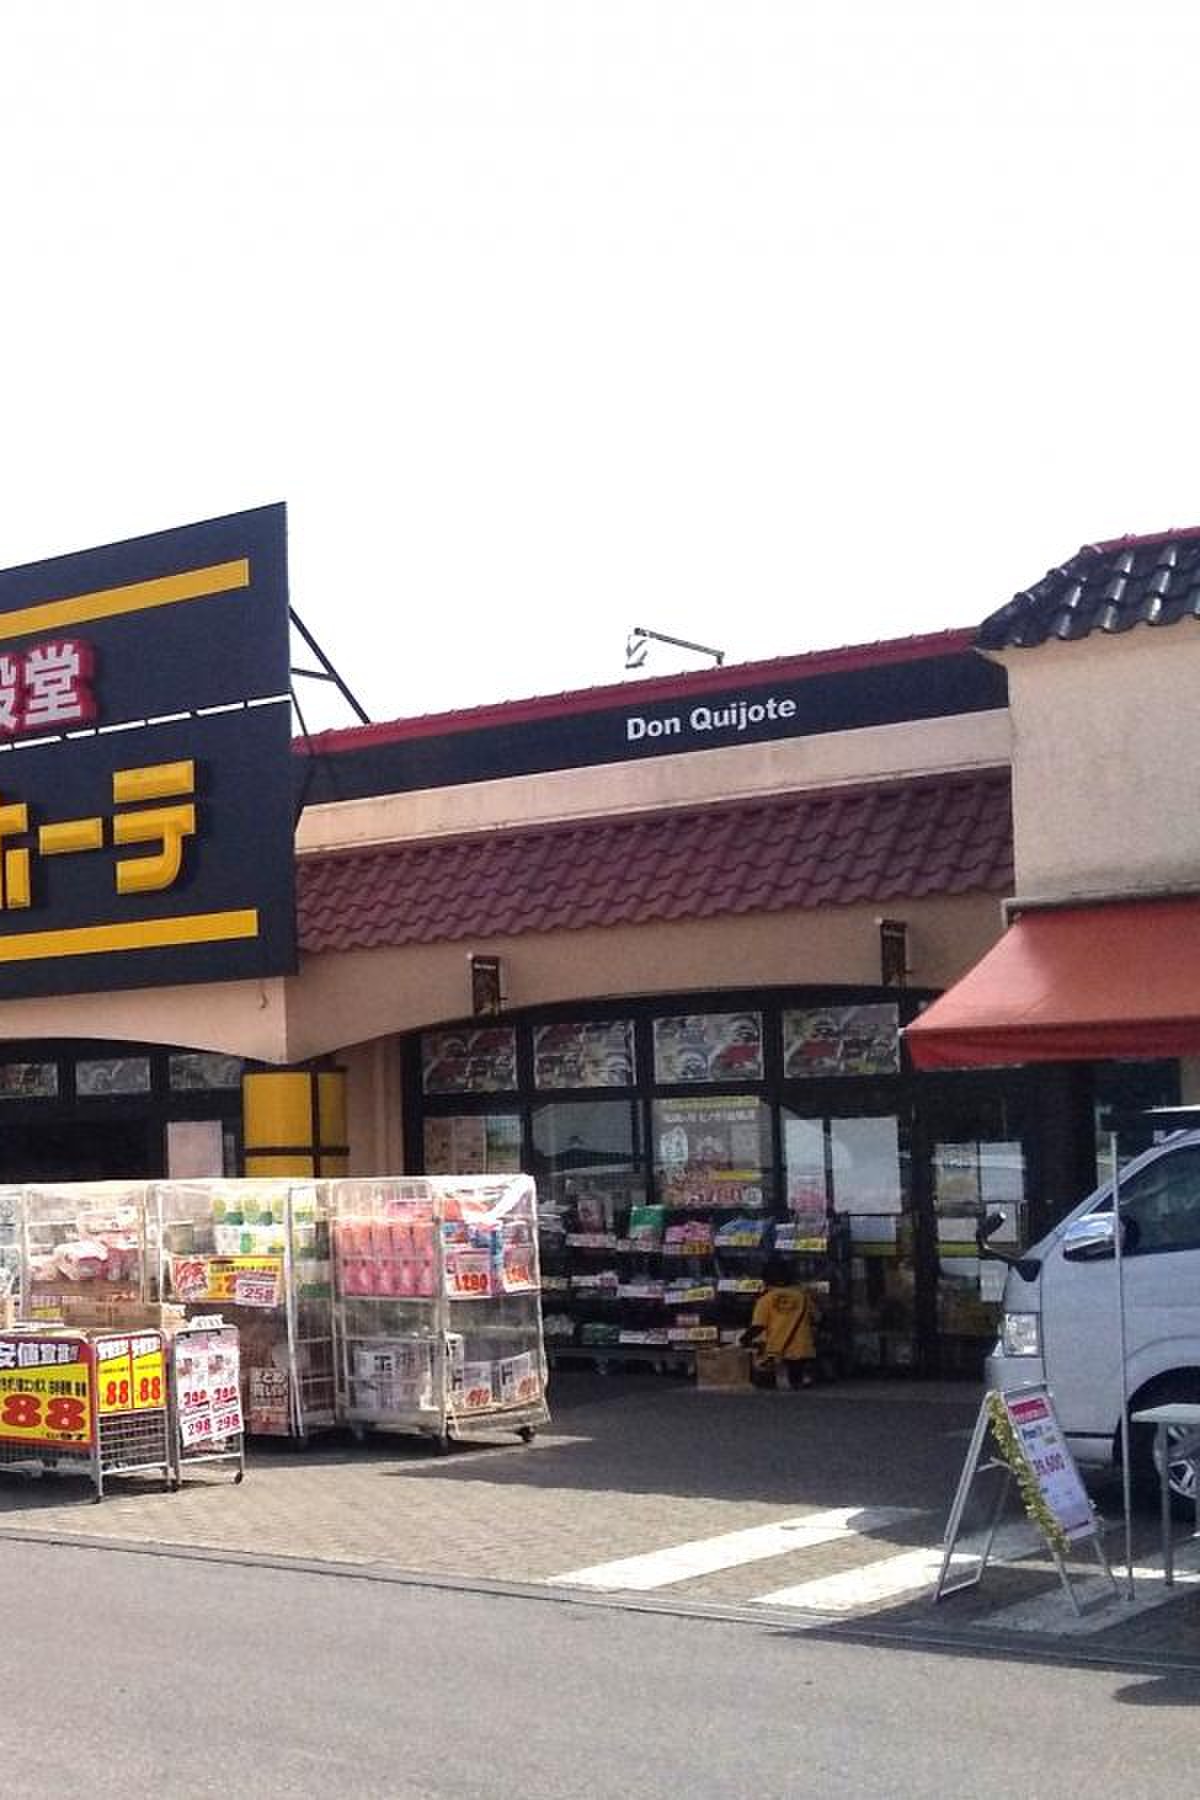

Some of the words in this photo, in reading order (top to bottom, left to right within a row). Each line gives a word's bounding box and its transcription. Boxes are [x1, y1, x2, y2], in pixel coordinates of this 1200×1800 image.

[626, 717, 681, 741] Don
[689, 698, 797, 731] Quijote
[106, 1379, 129, 1405] 88
[140, 1375, 161, 1402] 88
[187, 1418, 211, 1437] 298
[218, 1413, 241, 1432] 298
